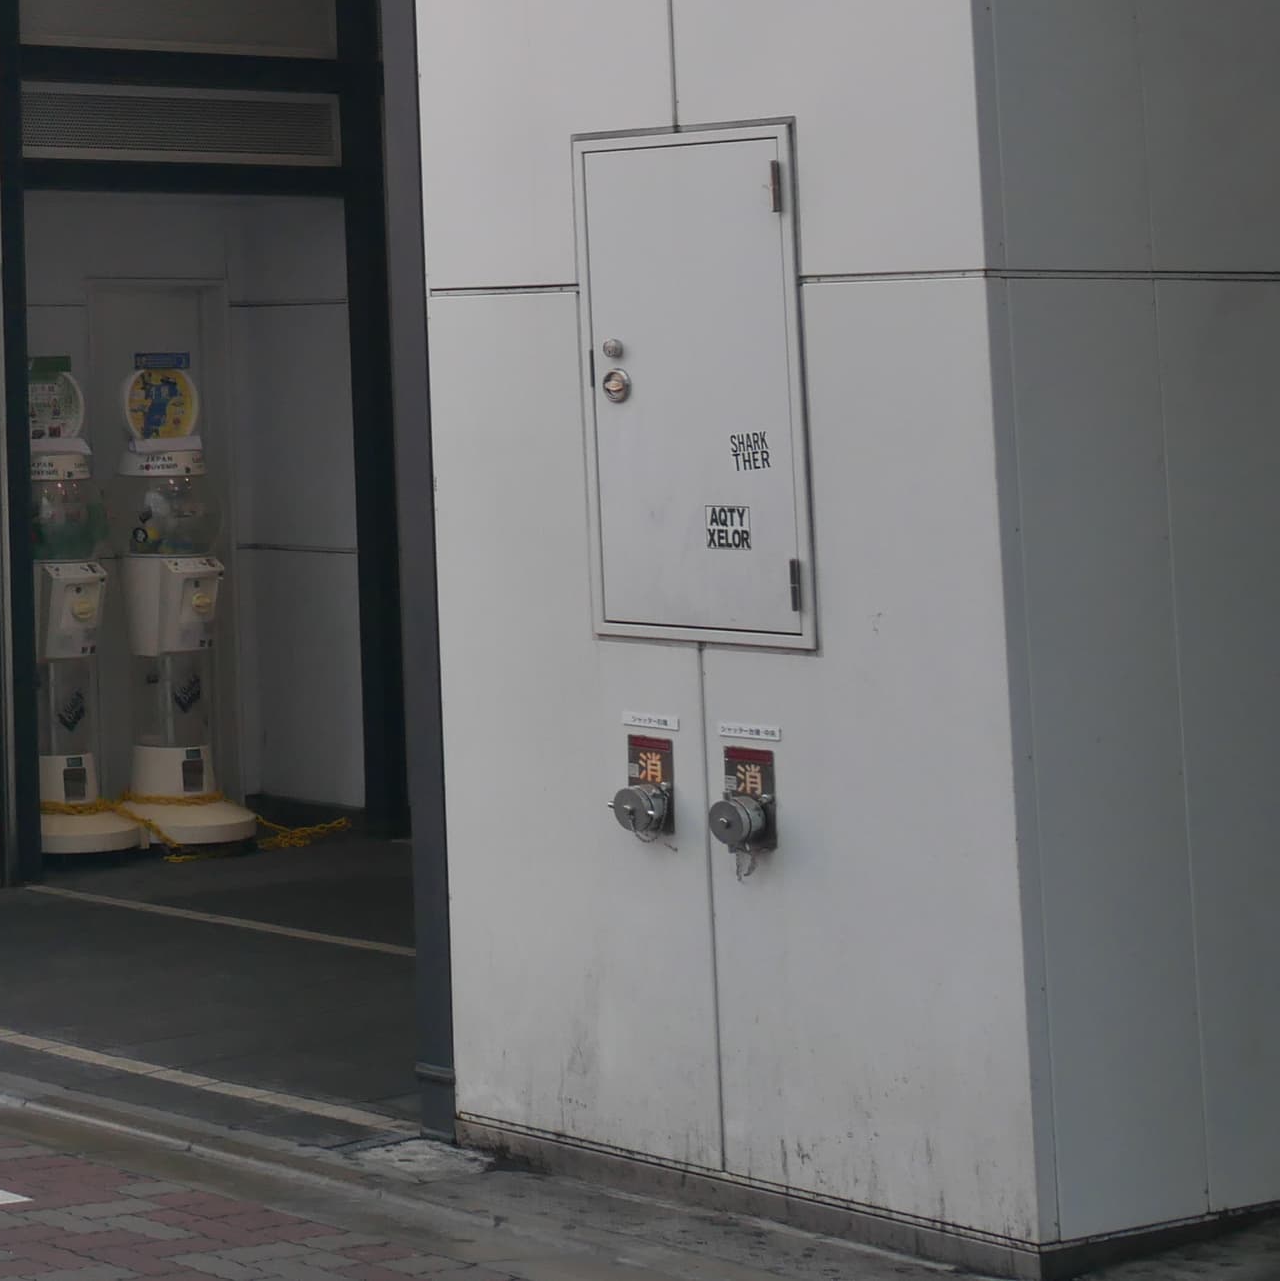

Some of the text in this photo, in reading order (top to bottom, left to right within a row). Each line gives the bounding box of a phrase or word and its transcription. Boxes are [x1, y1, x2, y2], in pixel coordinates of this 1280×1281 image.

[730, 431, 768, 453] SHARK
[732, 451, 771, 471] THER
[710, 508, 746, 527] AQTY
[707, 529, 751, 549] XELOR
[639, 752, 662, 783] 消
[736, 764, 762, 796] 消
